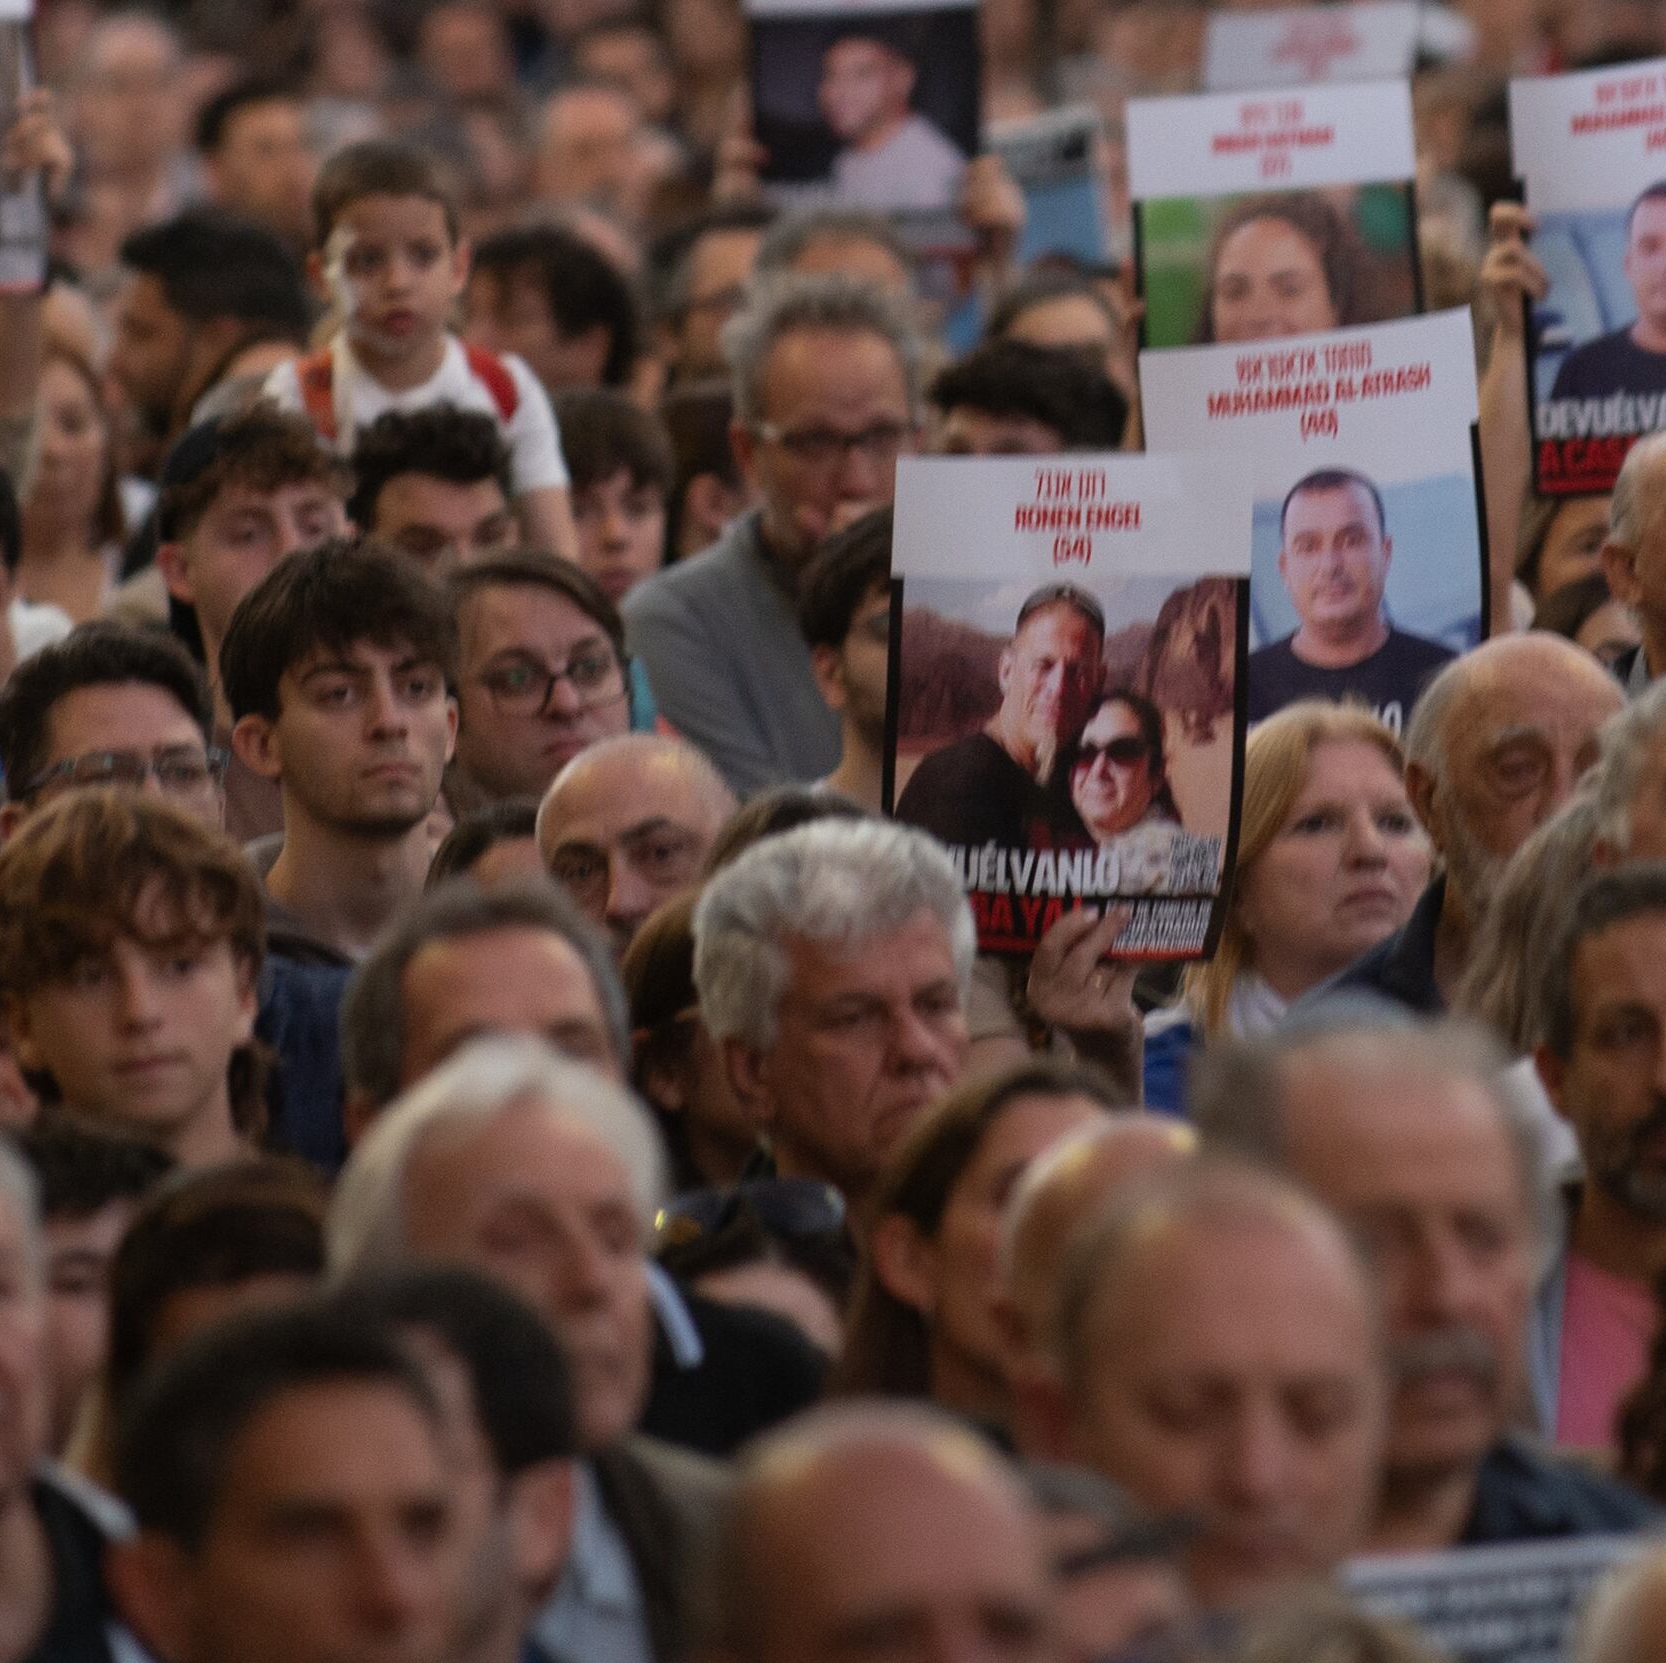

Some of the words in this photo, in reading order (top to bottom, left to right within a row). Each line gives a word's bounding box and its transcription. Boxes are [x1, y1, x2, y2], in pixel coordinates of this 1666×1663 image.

[1206, 380, 1331, 419] MUHAMMAD
[1014, 503, 1082, 532] RONEN
[1085, 502, 1141, 531] ENGEL
[1052, 534, 1093, 569] (54)
